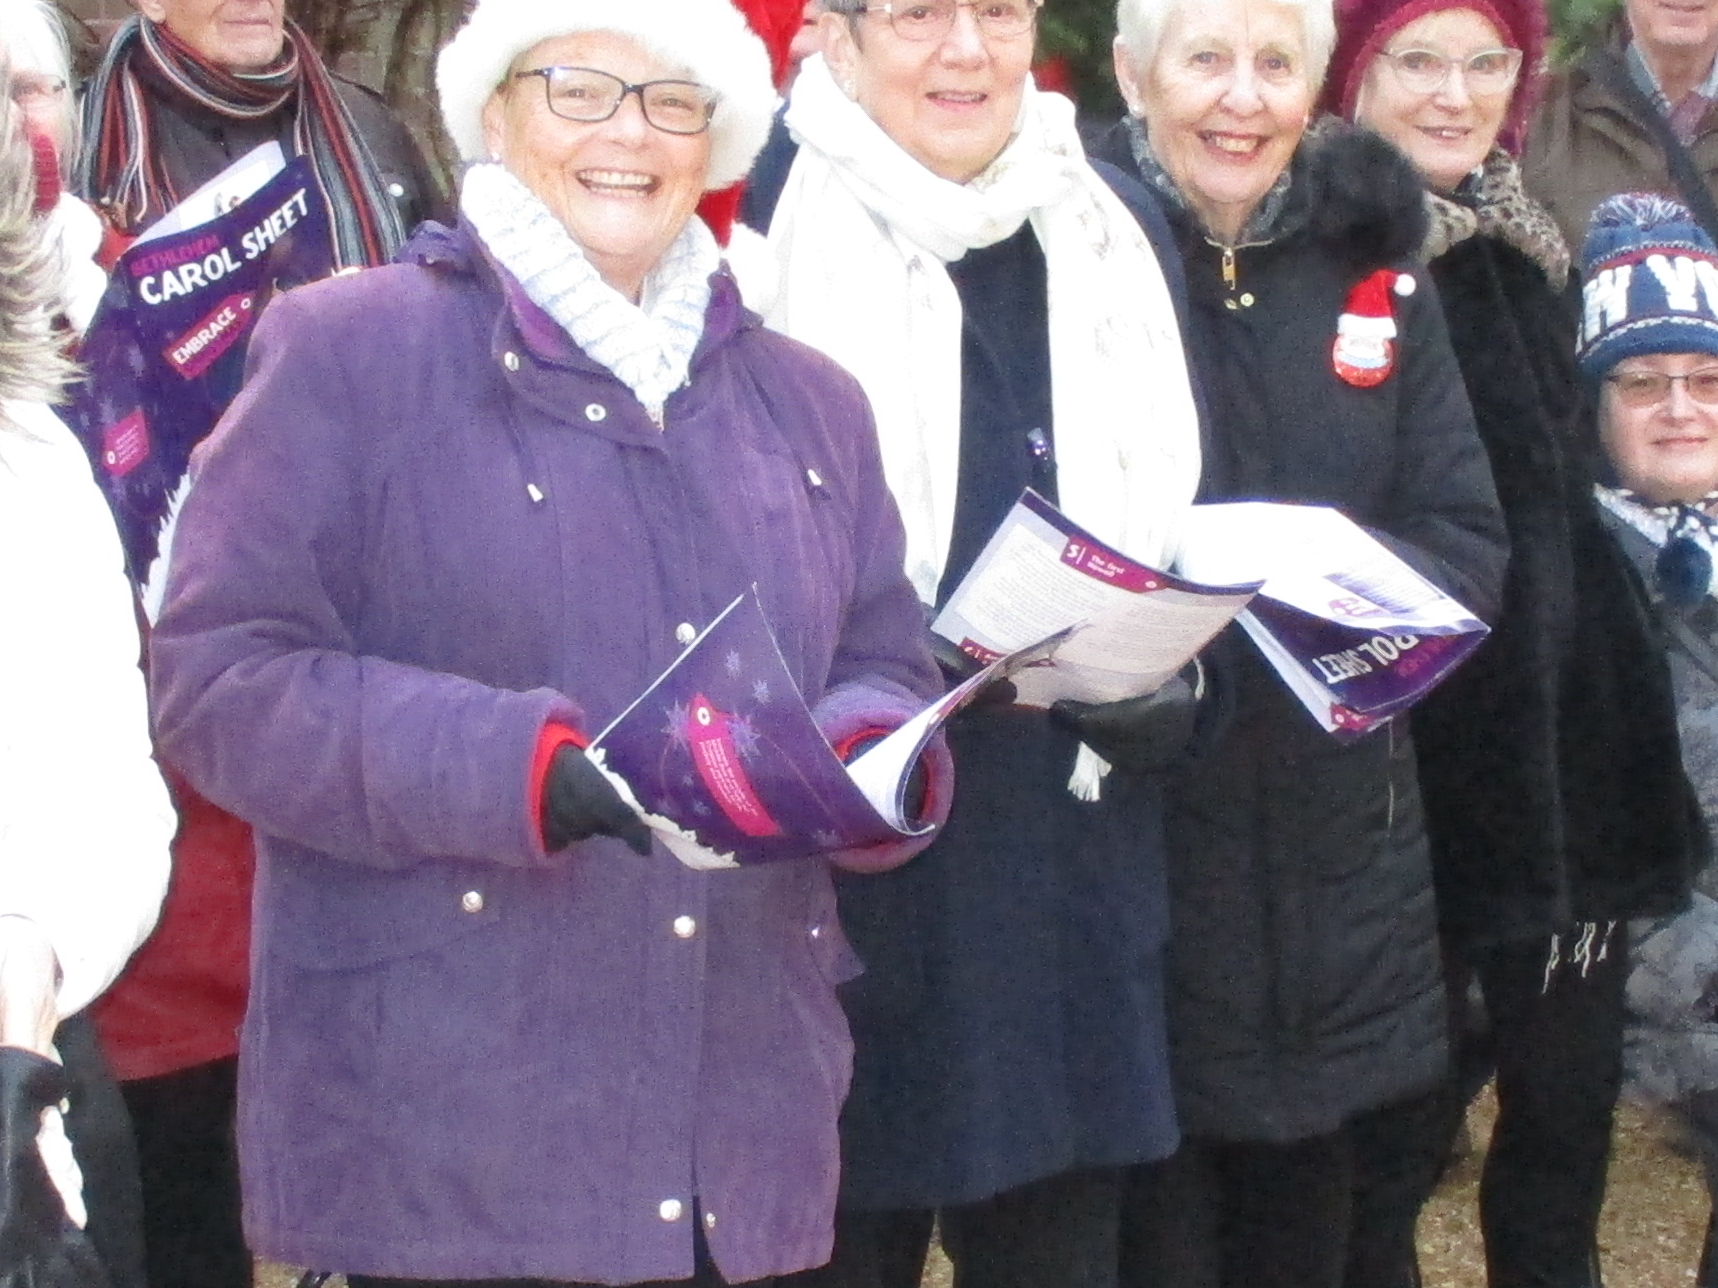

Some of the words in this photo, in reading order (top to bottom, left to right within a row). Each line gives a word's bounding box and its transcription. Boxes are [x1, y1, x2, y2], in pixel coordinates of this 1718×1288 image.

[139, 247, 242, 306] CAROL
[241, 187, 309, 260] SHEET
[171, 306, 237, 365] EMBRACE
[1311, 649, 1373, 684] SHEET
